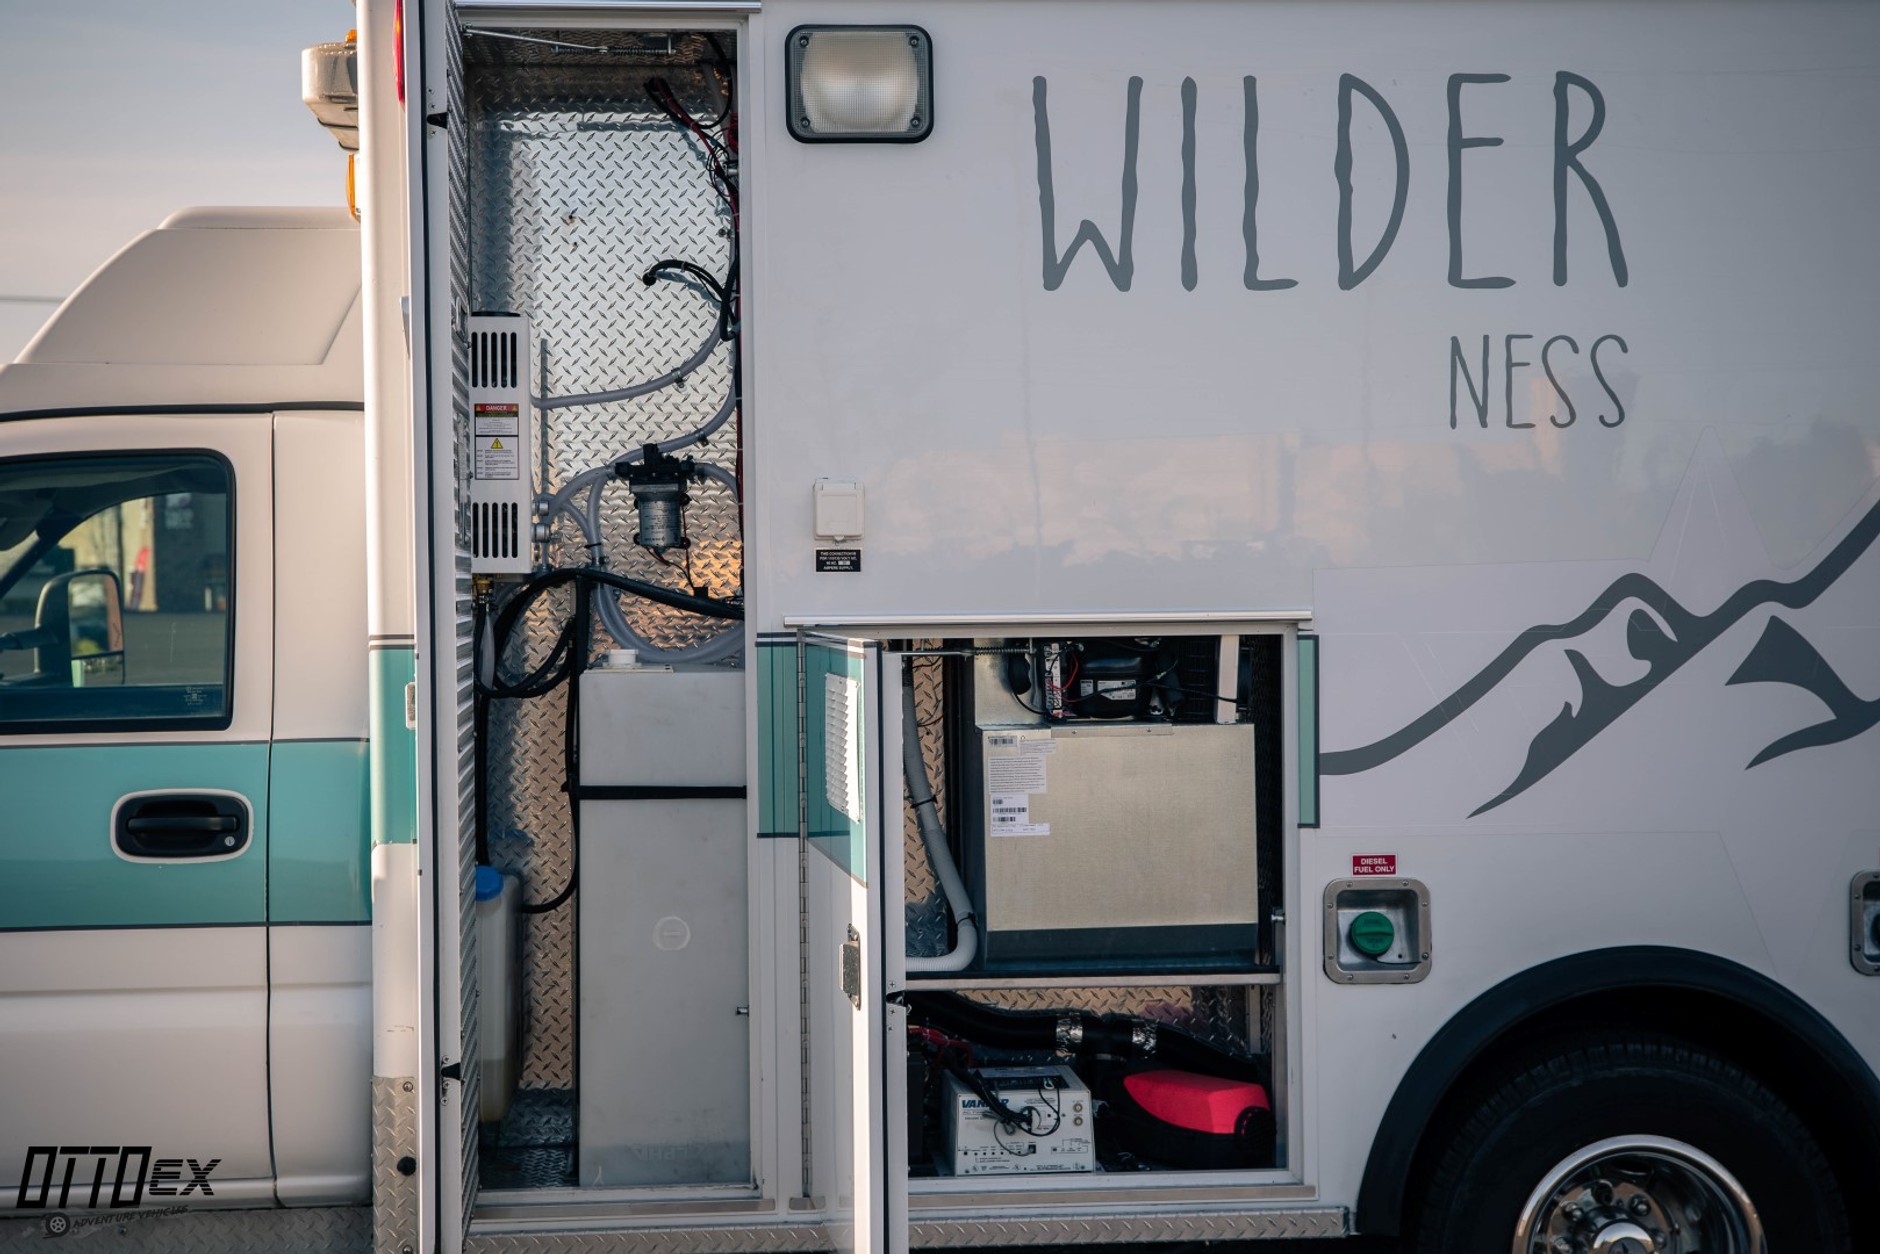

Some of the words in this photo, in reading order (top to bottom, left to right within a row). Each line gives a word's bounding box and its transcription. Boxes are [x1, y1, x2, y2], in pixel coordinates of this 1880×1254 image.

[1032, 70, 1629, 293] WILDER
[485, 404, 508, 412] DANGER
[1449, 333, 1629, 430] NESS
